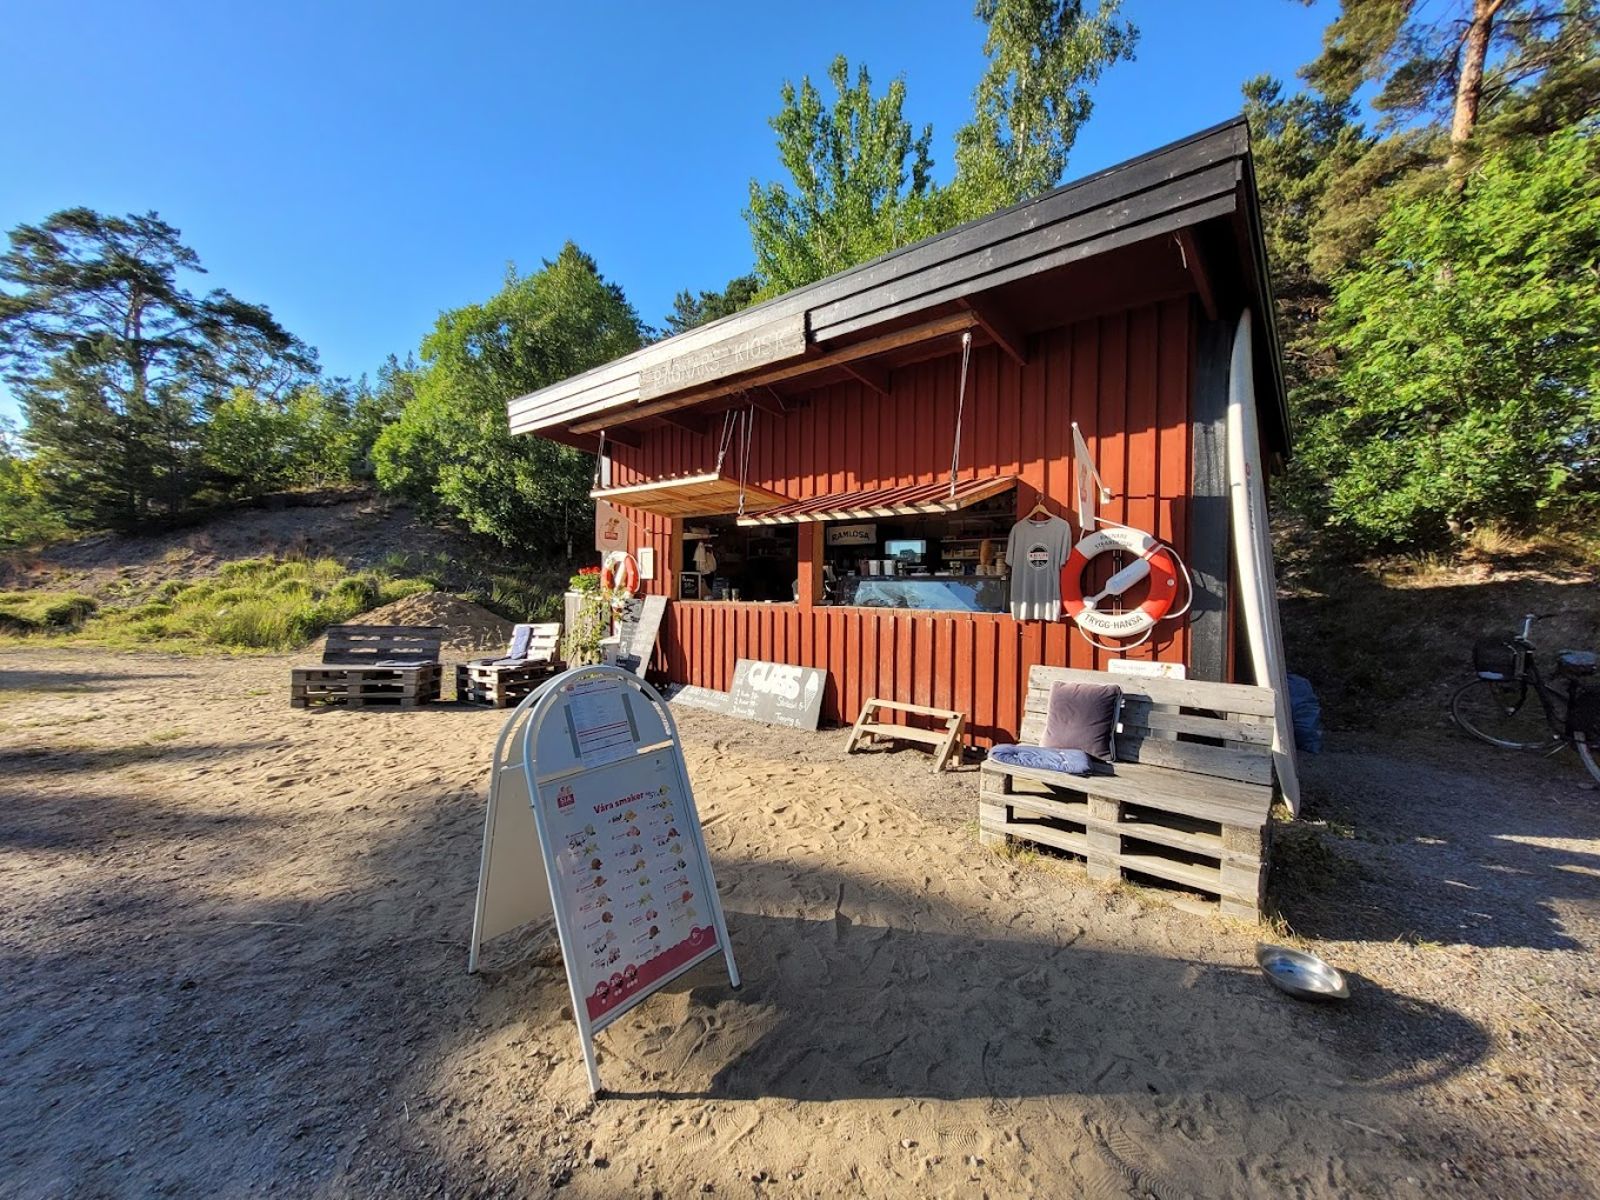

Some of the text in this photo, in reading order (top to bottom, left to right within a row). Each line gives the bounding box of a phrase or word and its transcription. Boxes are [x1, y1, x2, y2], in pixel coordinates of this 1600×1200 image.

[735, 333, 785, 362] KIOSK
[1085, 614, 1143, 629] TRYGG-HANSA
[593, 802, 614, 814] Våra
[615, 791, 644, 807] smaker
